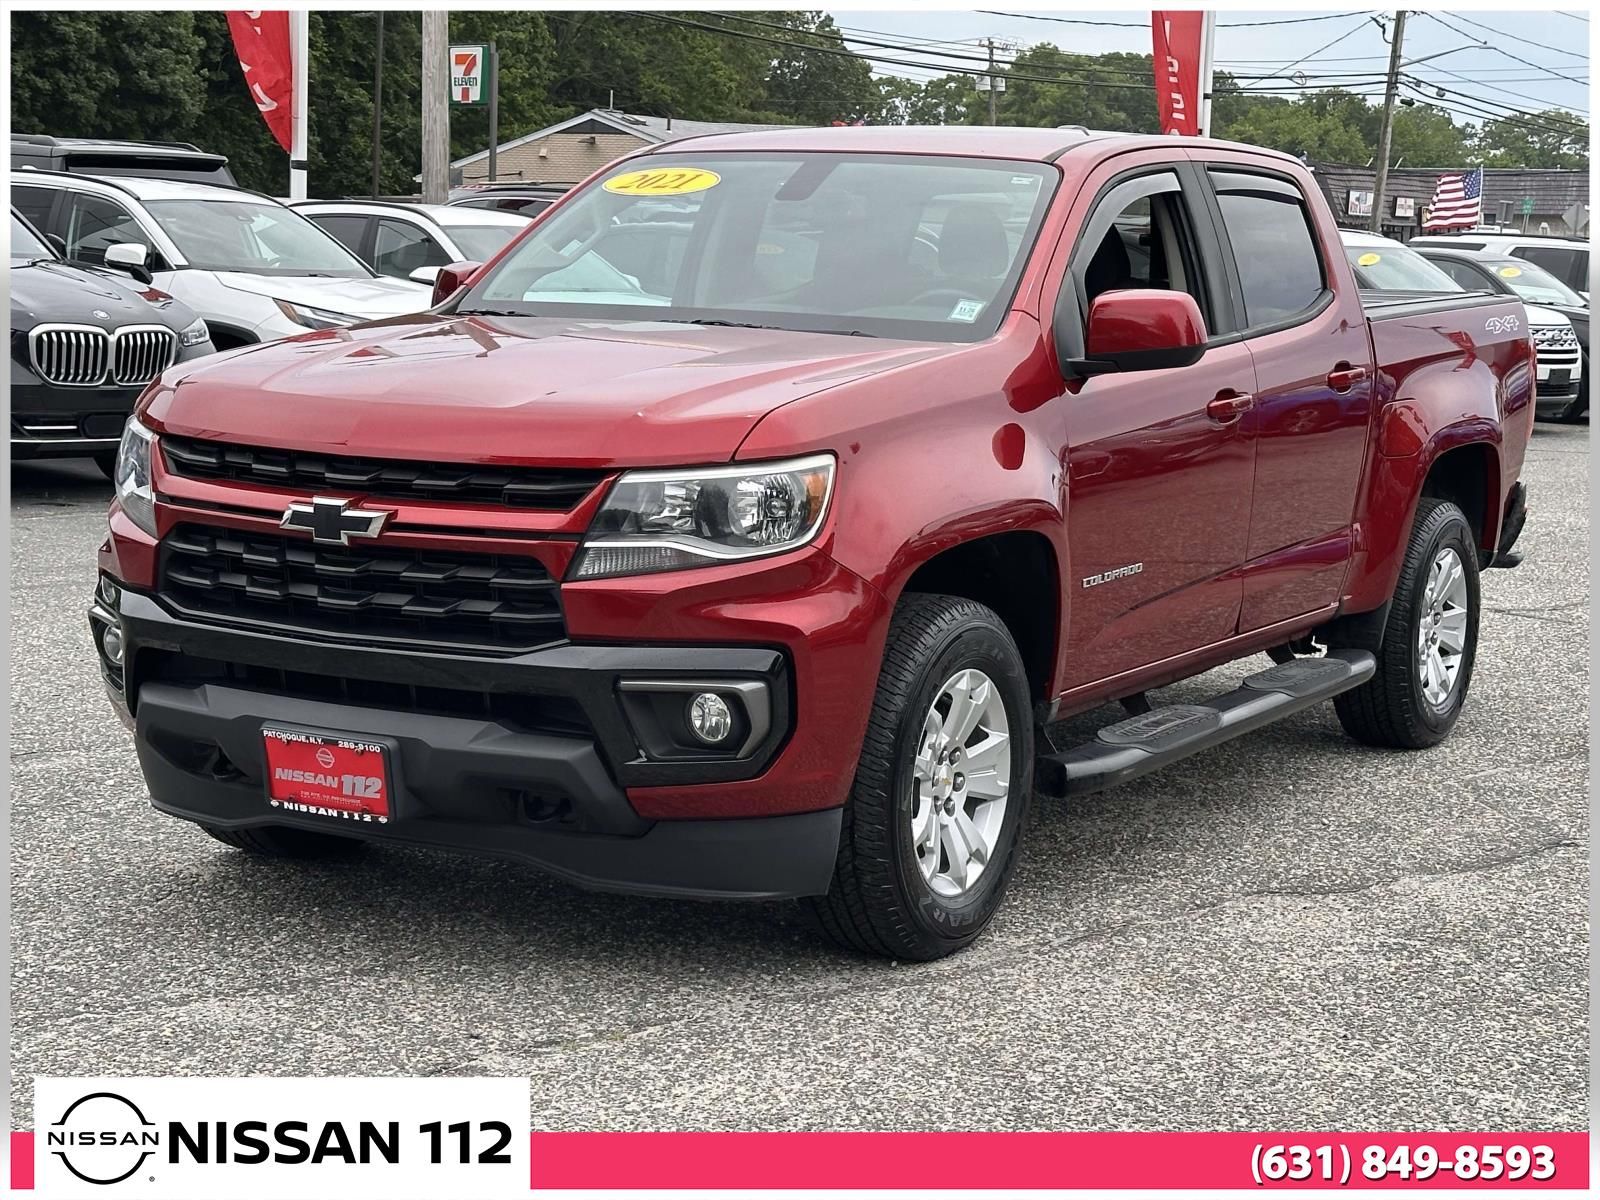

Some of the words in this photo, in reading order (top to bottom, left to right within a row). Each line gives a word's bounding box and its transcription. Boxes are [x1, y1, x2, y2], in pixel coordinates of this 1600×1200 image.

[616, 173, 703, 189] 2021
[1082, 562, 1143, 588] COLORADO
[338, 741, 381, 753] 289-9100
[275, 767, 338, 788] NISSAN
[341, 774, 382, 799] 112
[284, 802, 338, 817] NISSAN
[342, 811, 372, 822] 112
